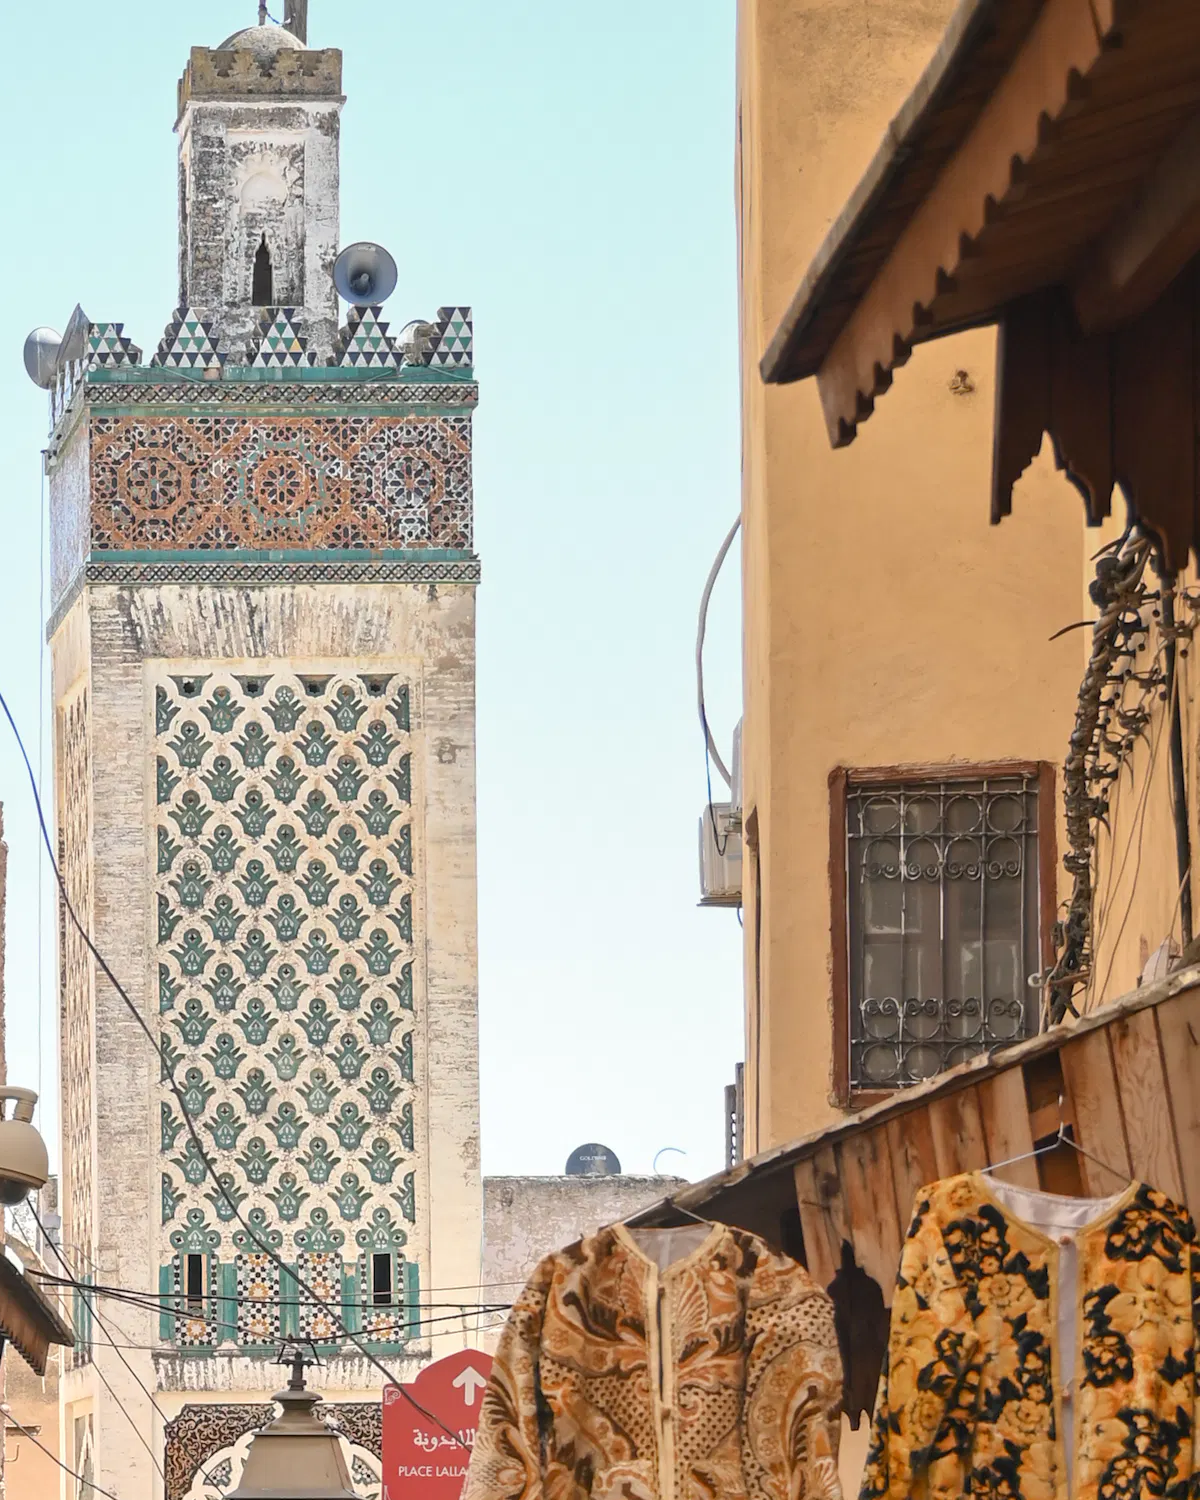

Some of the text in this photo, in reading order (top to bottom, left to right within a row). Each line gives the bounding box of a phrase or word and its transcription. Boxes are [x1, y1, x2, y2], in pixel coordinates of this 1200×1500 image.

[413, 1428, 457, 1452] يدونة
[399, 1465, 468, 1477] PLACE LALLA
